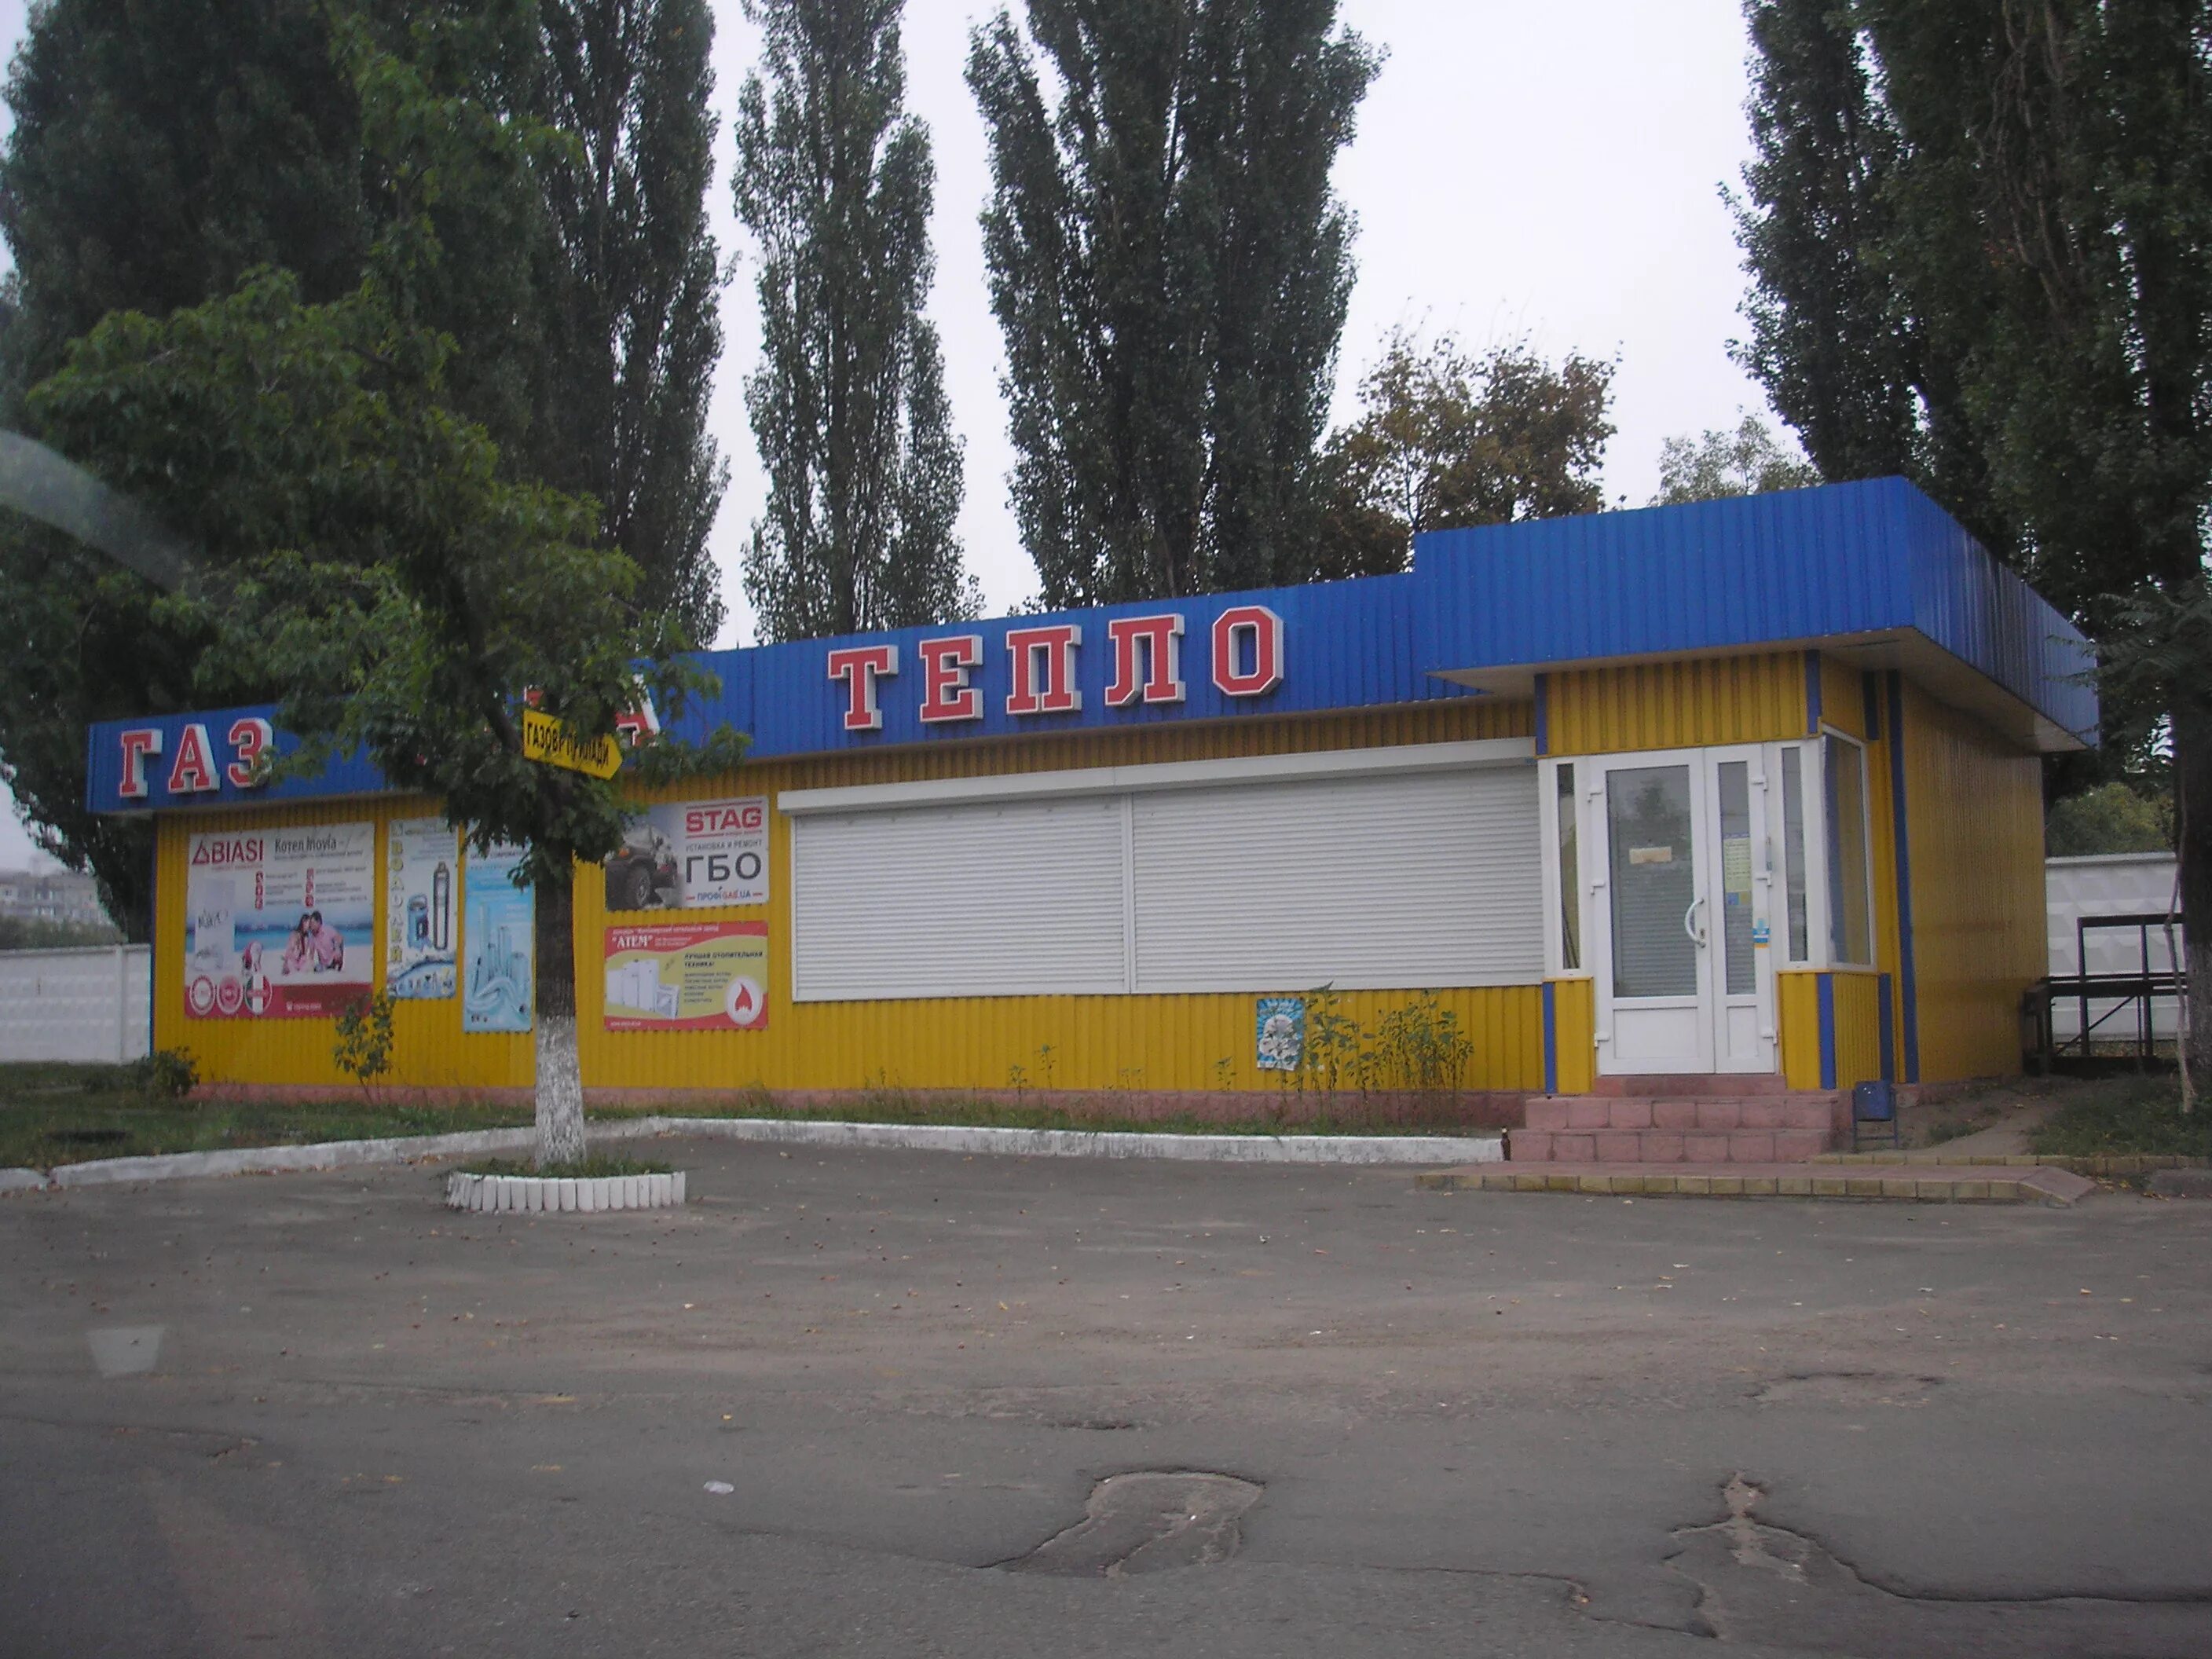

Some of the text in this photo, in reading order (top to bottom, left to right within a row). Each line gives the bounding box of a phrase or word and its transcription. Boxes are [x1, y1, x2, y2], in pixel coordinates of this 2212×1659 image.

[120, 606, 1284, 797] ГАЗ ТЕПЛО
[686, 807, 763, 832] STAG
[211, 837, 264, 864] BIASI
[734, 839, 763, 848] РЕМОНТ
[686, 851, 762, 883] ГБО
